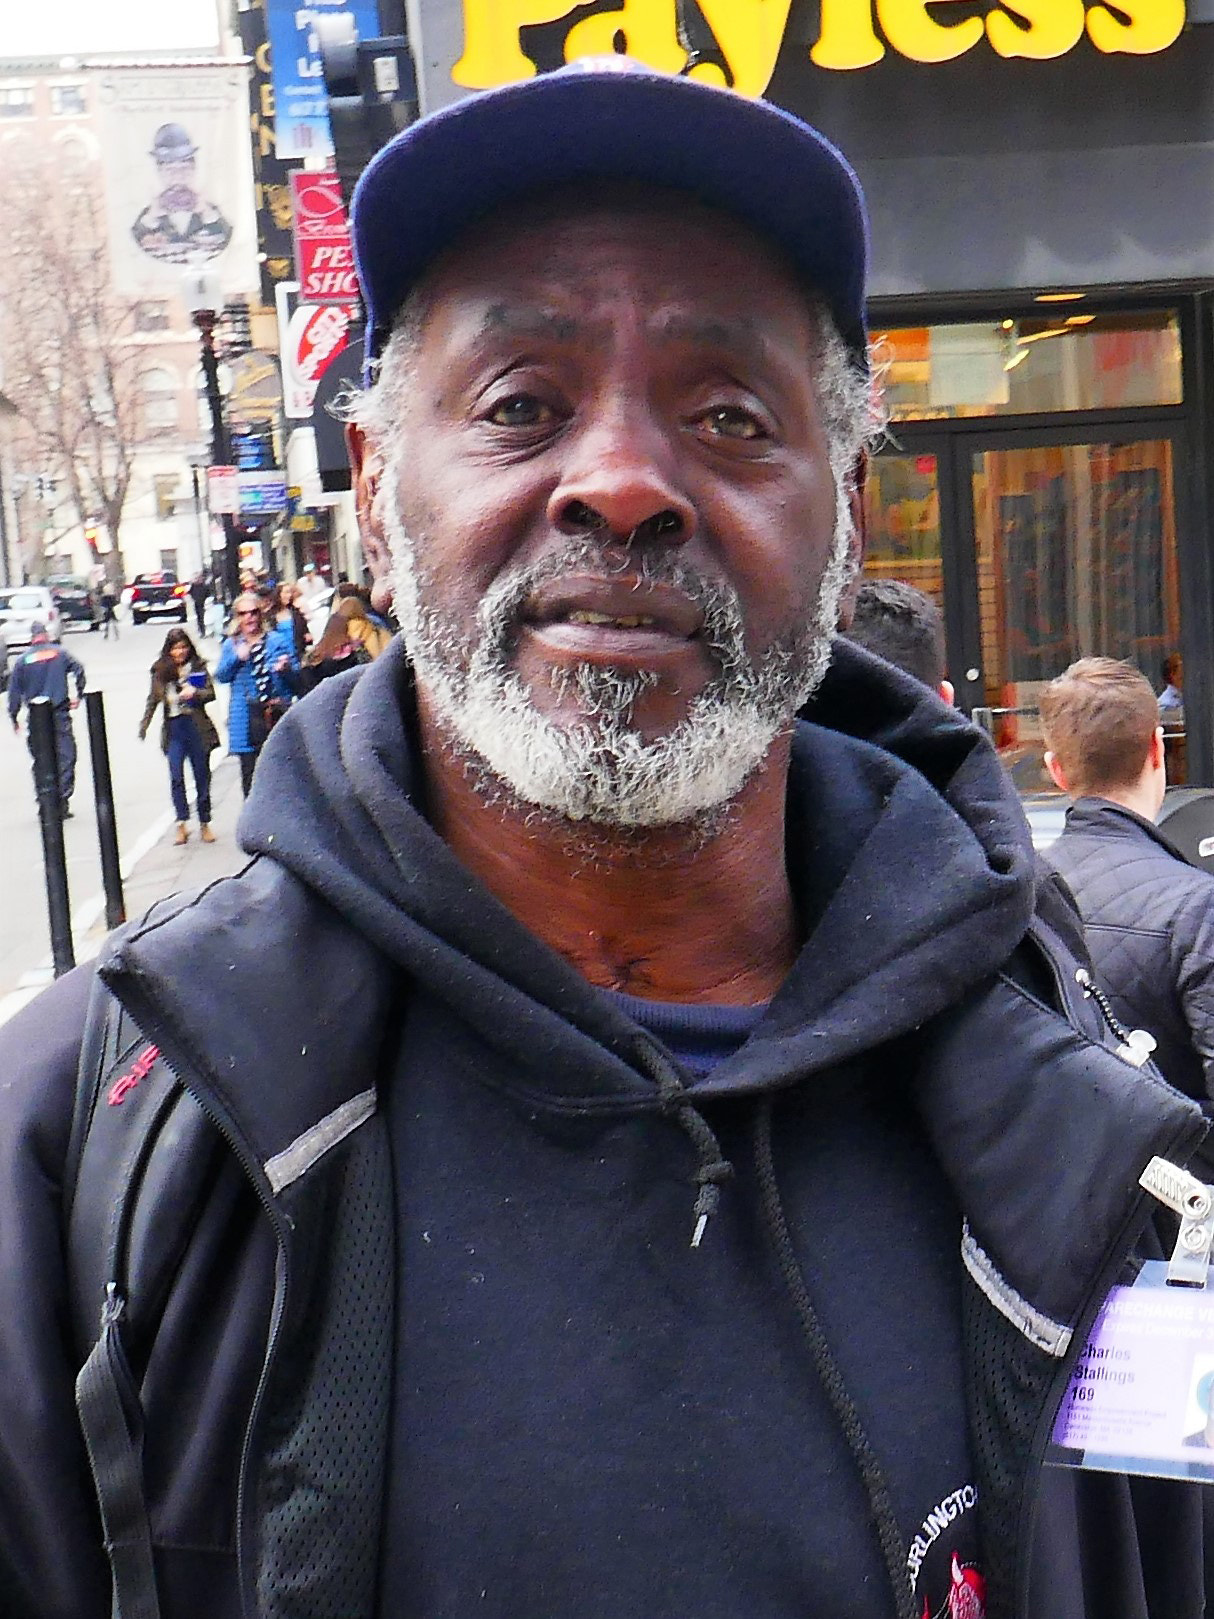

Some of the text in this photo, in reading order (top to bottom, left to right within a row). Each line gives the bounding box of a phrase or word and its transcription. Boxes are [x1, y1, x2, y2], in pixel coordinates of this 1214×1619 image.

[311, 245, 355, 268] PE
[1074, 1364, 1136, 1385] Stallings
[1072, 1386, 1095, 1401] 169
[907, 1485, 978, 1596] URLINGTO
